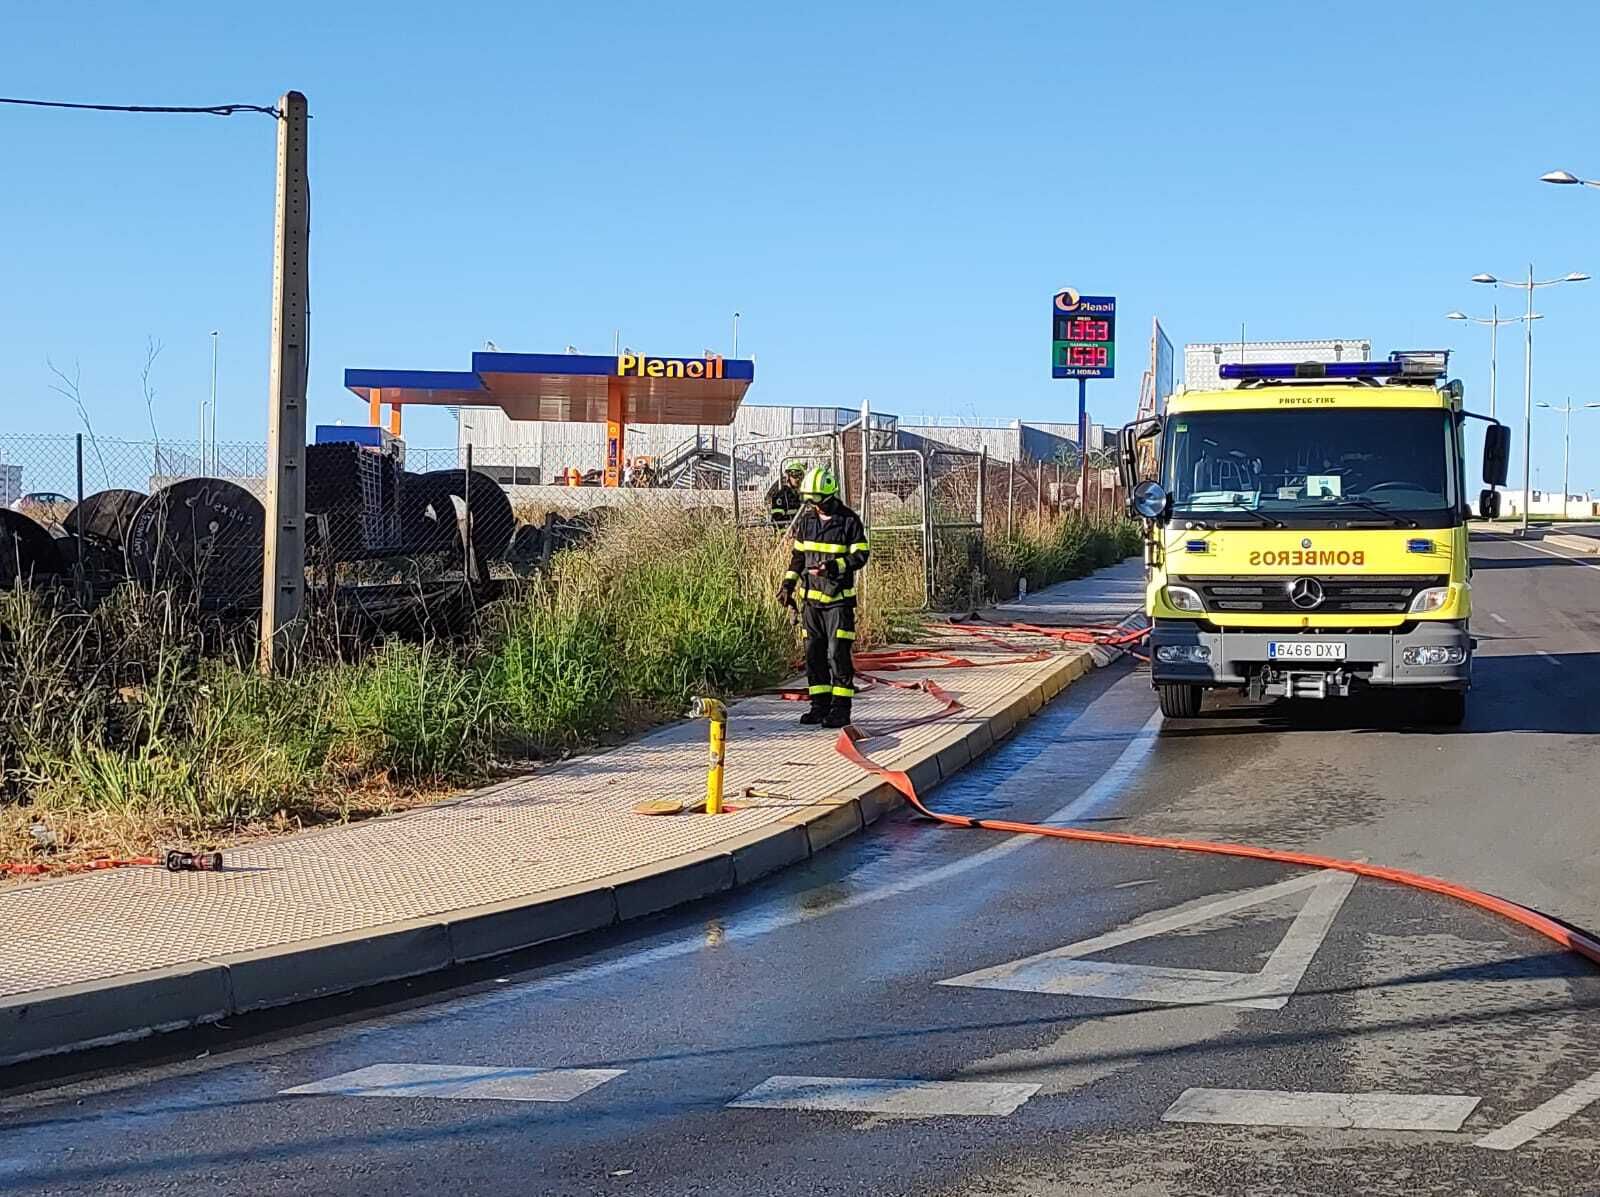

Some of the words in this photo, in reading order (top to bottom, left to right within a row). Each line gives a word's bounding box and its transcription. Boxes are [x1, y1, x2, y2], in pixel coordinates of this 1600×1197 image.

[1080, 302, 1114, 311] Plenoil
[617, 352, 723, 379] Plenoil
[1277, 644, 1312, 656] 6466
[1316, 644, 1341, 657] DXY
